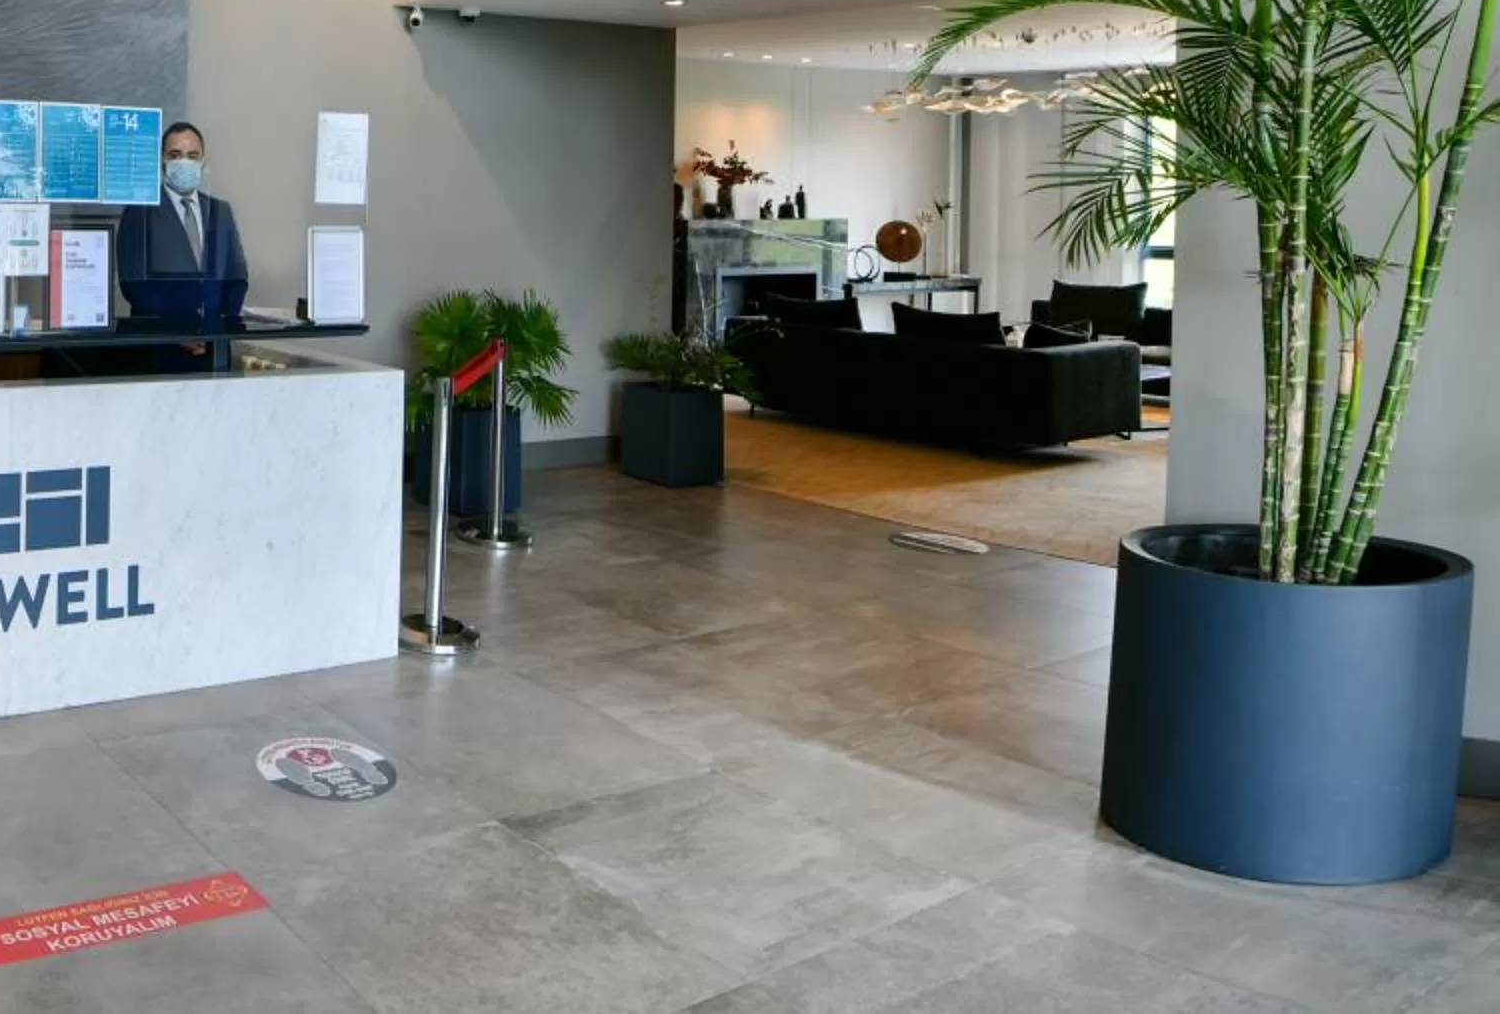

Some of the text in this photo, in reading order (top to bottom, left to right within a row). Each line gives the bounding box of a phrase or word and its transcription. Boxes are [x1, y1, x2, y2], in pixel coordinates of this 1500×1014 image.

[120, 112, 139, 131] 14
[0, 918, 90, 945] SOSYAL
[92, 891, 200, 927] MESAFEYİ
[45, 914, 177, 952] KORUYALIM
